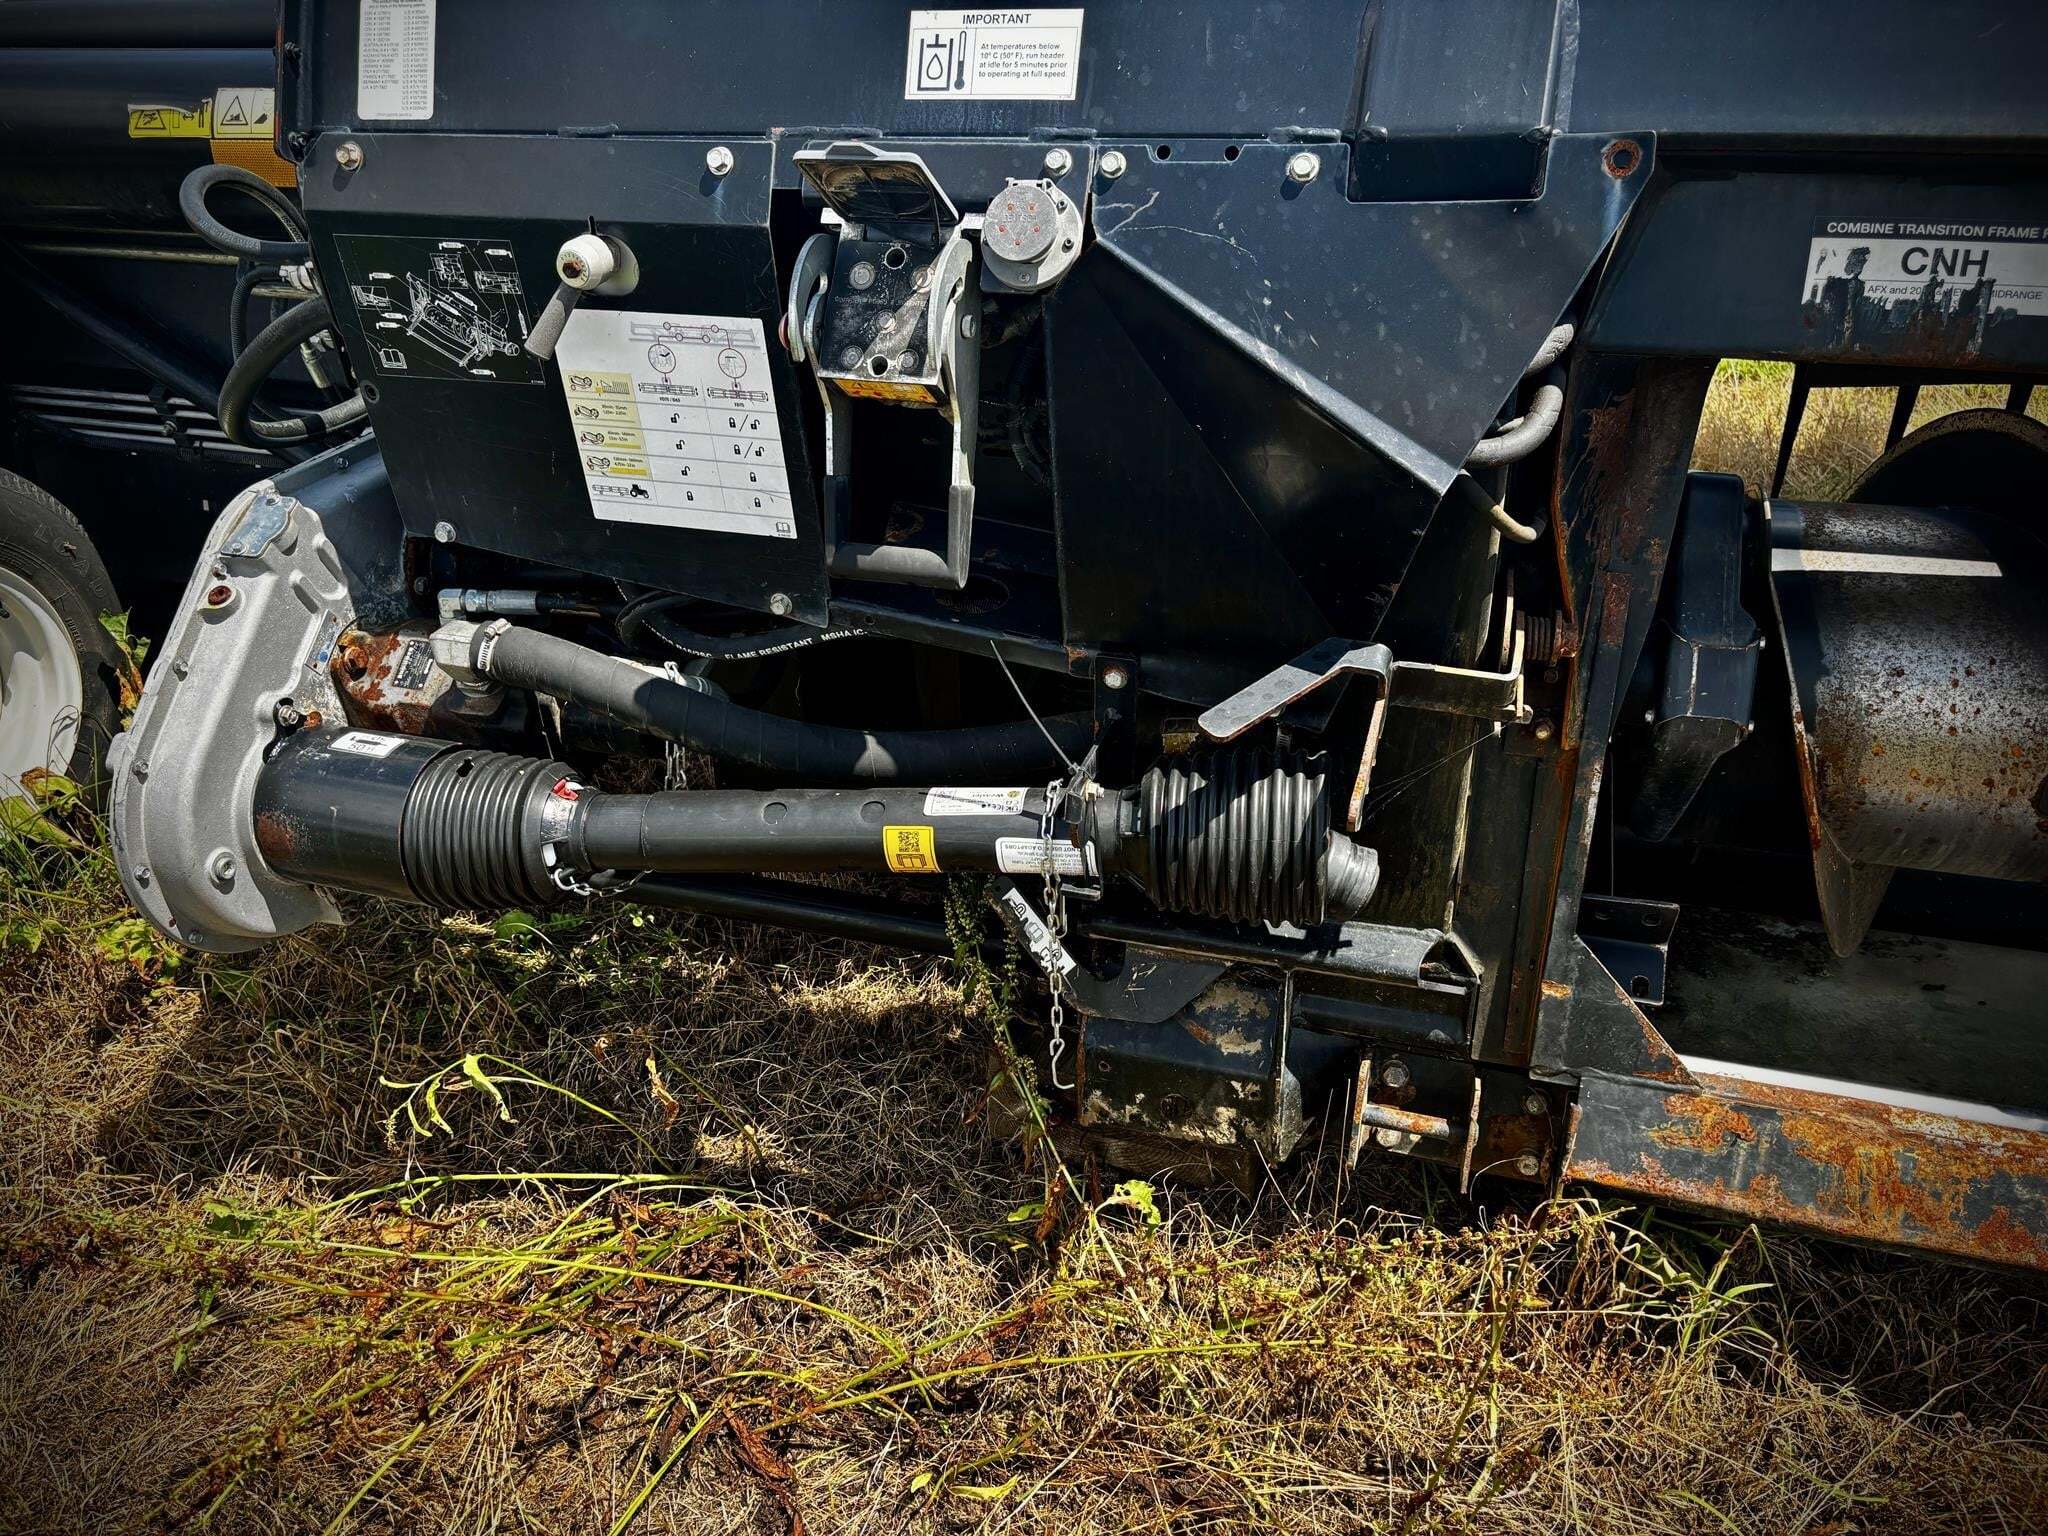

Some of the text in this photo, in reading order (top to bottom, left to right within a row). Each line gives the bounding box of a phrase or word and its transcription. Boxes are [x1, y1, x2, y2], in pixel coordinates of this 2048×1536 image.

[962, 13, 1032, 24] IMPORTANT
[990, 43, 1037, 51] temperatures
[987, 71, 1021, 79] operating
[1826, 222, 1895, 235] COMBINE
[1898, 223, 1986, 237] TRANSITION
[1987, 226, 2039, 239] FRAME
[1901, 247, 1989, 277] CNH
[1867, 285, 1888, 294] AFX
[1889, 285, 1908, 294] and
[724, 650, 759, 660] FLAME
[759, 637, 813, 656] RESISTANT
[820, 629, 852, 641] MSHA
